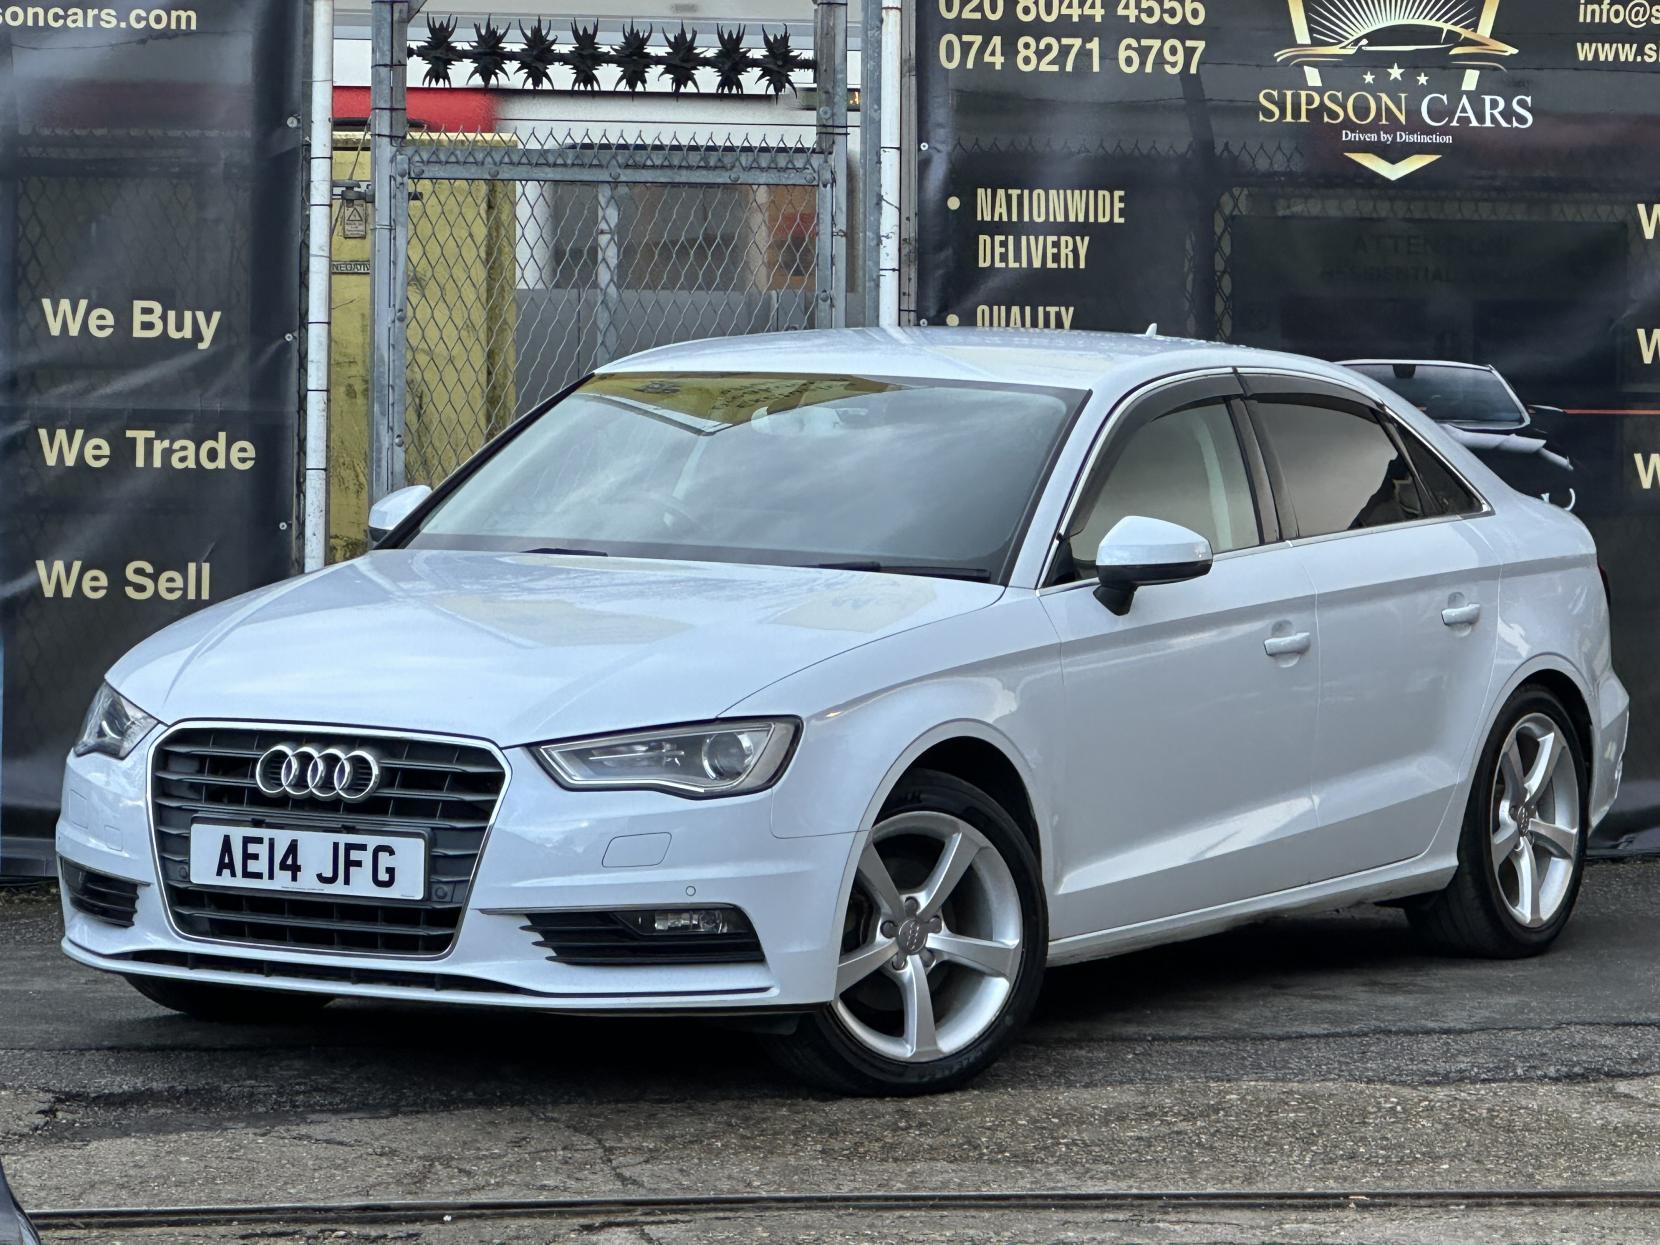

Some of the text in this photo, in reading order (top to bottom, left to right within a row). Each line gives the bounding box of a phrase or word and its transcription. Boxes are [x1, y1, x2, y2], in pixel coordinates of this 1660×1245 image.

[0, 6, 197, 30] oncars.com
[938, 0, 1206, 26] 020 8044 4556
[938, 34, 1206, 75] 074 8271 6797
[1576, 42, 1660, 63] www.s
[1258, 89, 1534, 129] SIPSON CARS
[1341, 129, 1453, 145] Driven by Distinction
[976, 187, 1125, 224] NATIONWIDE
[978, 234, 1090, 269] DELIVERY
[41, 298, 222, 350] We Buy
[37, 428, 256, 470] We Trade
[35, 559, 211, 601] We Sell
[215, 834, 396, 889] AE14 JFG
